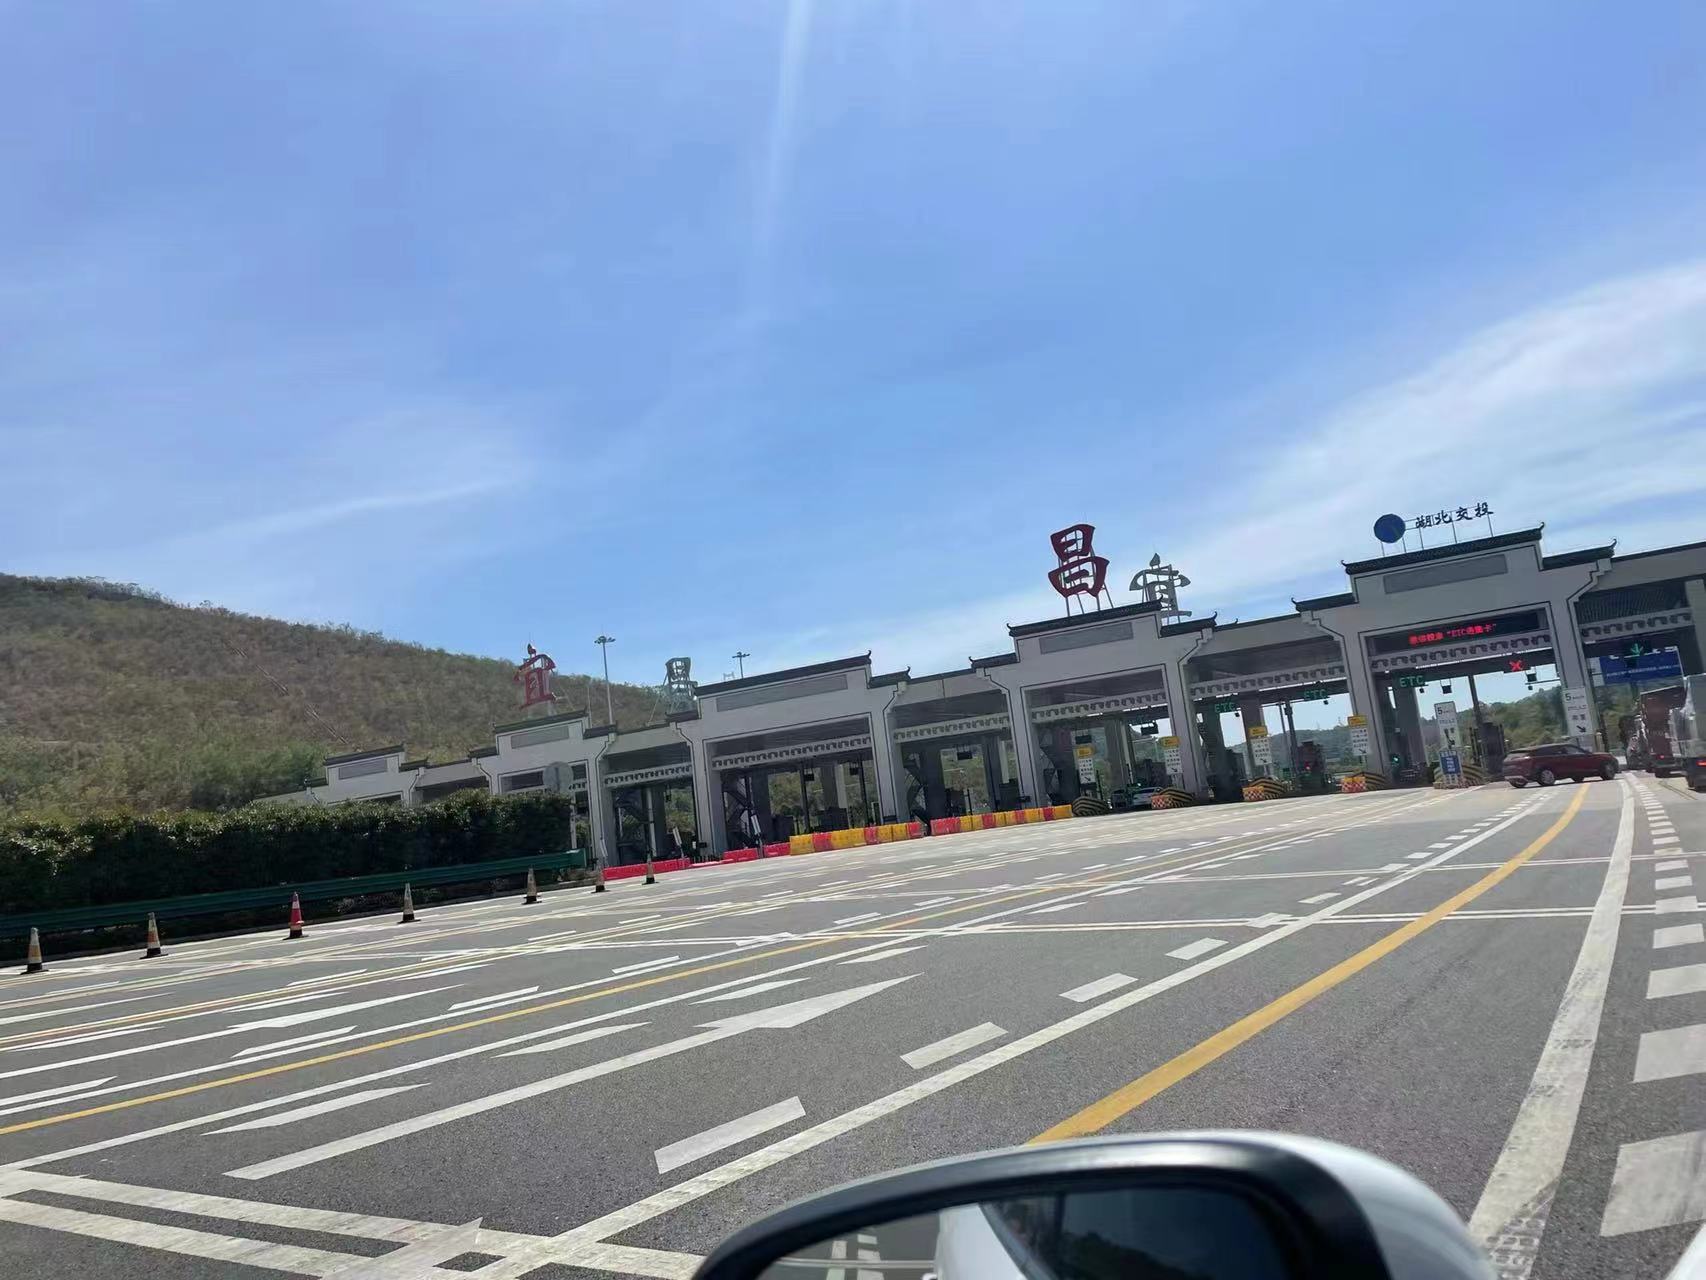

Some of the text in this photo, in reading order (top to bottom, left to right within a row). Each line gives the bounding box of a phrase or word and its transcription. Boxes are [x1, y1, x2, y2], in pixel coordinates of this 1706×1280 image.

[1415, 502, 1494, 528] 湖北交投
[1048, 524, 1110, 597] 昌
[514, 644, 557, 709] 宜
[1399, 677, 1425, 688] ETC
[1305, 690, 1327, 700] ETC
[1215, 702, 1236, 712] ETC
